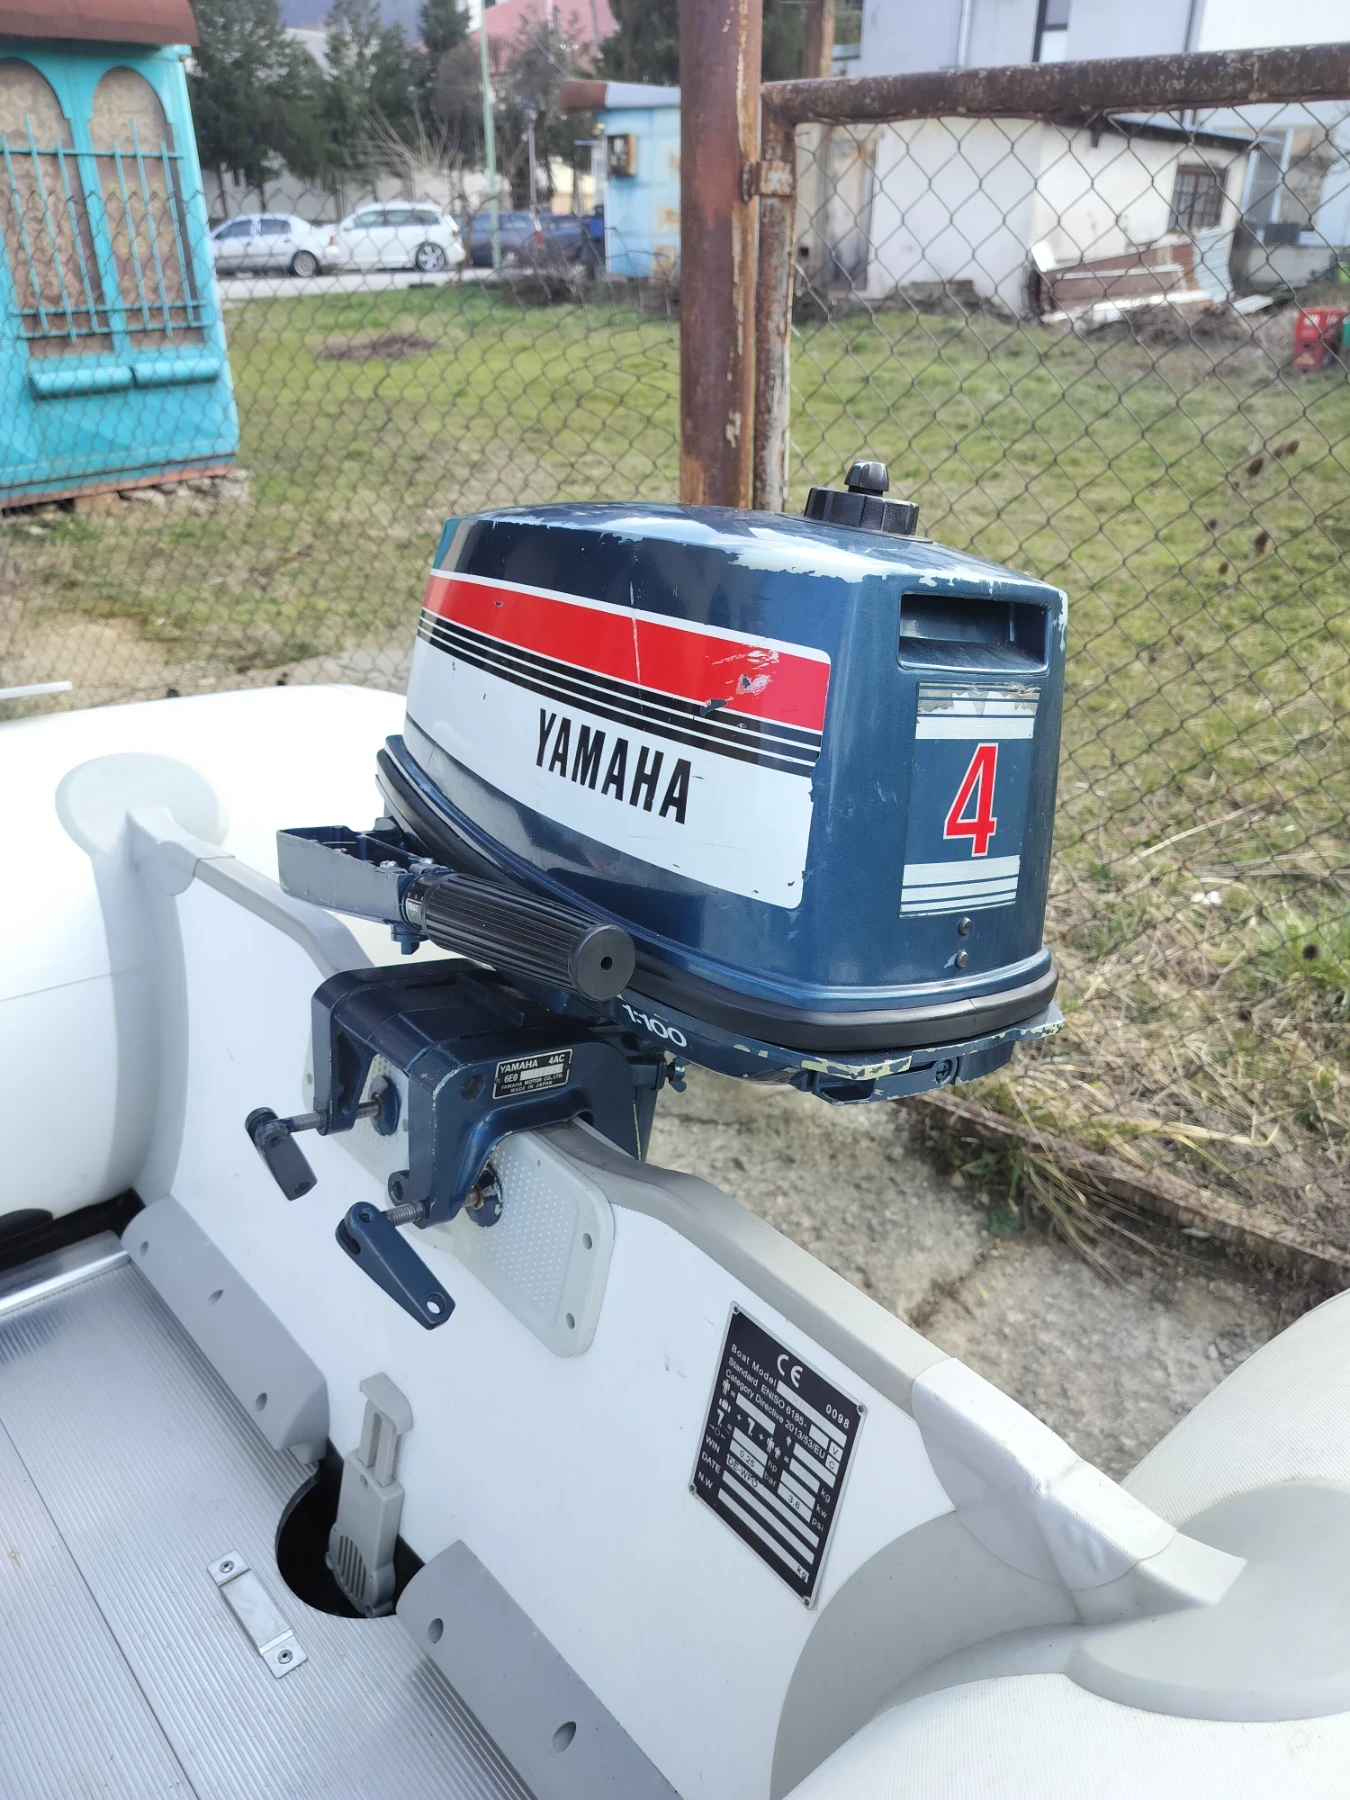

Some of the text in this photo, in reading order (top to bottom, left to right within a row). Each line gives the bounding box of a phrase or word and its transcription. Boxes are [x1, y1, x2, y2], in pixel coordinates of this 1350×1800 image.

[536, 708, 691, 825] YAMAHA
[943, 743, 999, 857] 4
[621, 1004, 688, 1047] 1:100
[500, 1054, 565, 1074] YAMAHA 4AC
[501, 1082, 522, 1090] YAMAHA
[524, 1077, 542, 1085] MOTOR
[731, 1344, 777, 1388] Boat Model
[726, 1368, 754, 1398] Category
[755, 1394, 784, 1424] Directive
[784, 1420, 826, 1459] 2013/53/EU
[828, 1460, 834, 1470] C
[728, 1356, 758, 1387] Standard
[832, 1446, 839, 1456] V
[826, 1404, 850, 1429] 0098
[702, 1452, 722, 1474] DATE
[706, 1434, 720, 1454] WIN
[740, 1450, 824, 1532] 0.25 bar 3.6 psi
[768, 1459, 828, 1518] hp kw
[820, 1488, 831, 1504] kg
[796, 1566, 807, 1580] kg
